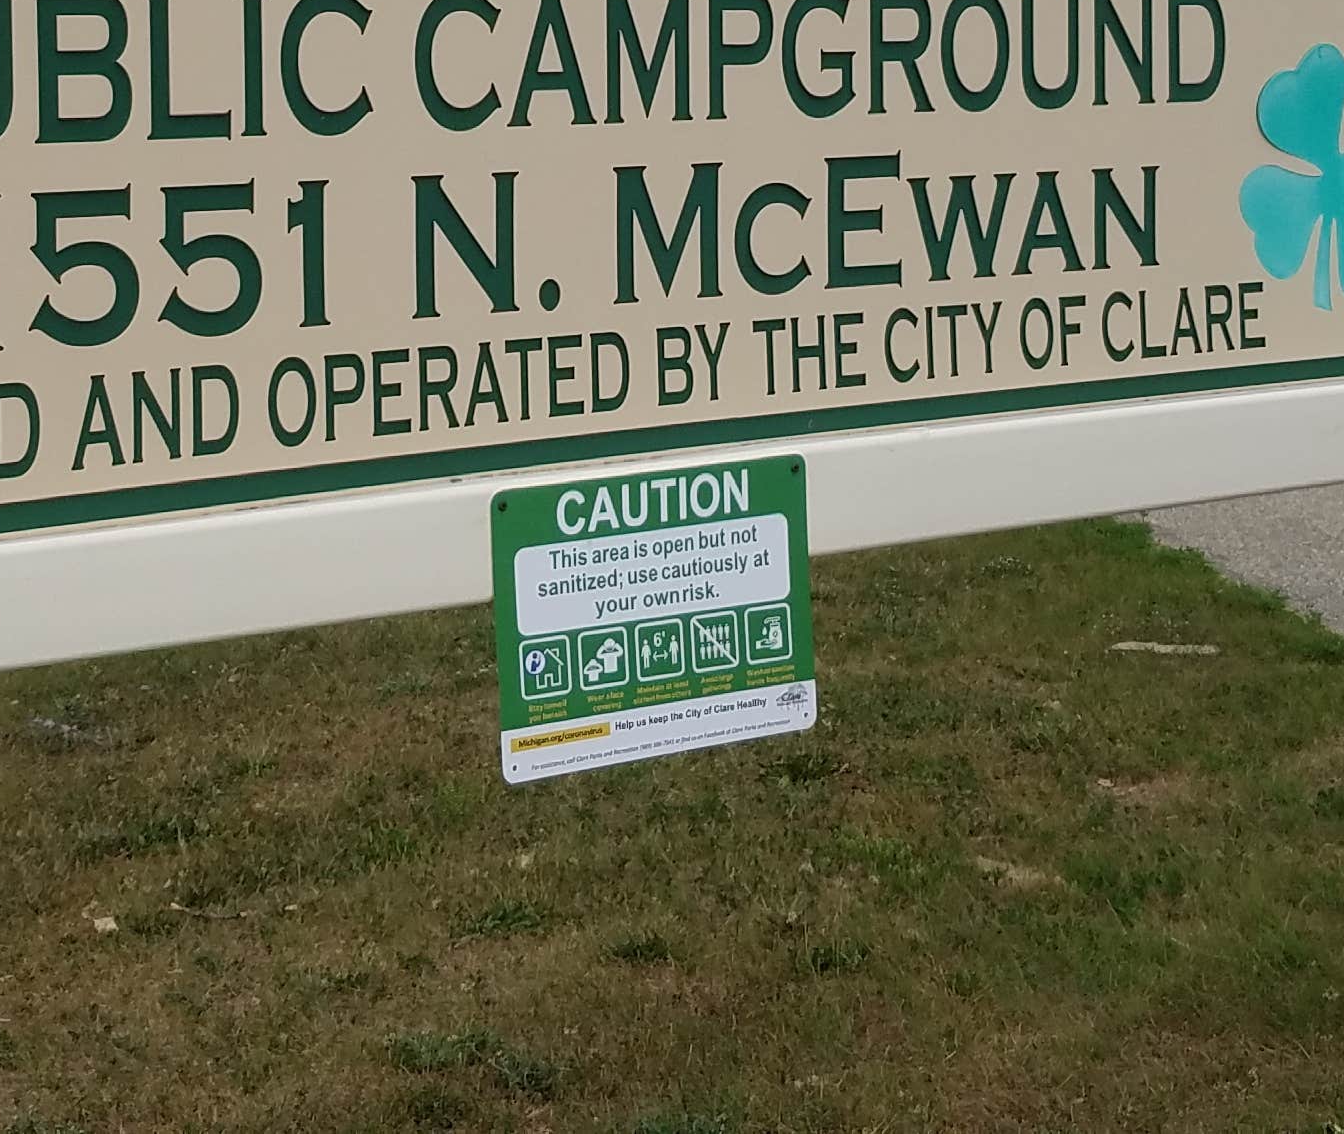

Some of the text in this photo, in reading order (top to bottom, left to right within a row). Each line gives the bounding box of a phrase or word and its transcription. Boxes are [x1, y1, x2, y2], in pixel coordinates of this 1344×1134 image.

[409, 170, 562, 321] N.
[70, 363, 241, 472] AND
[266, 330, 631, 449] OPERATED
[654, 320, 732, 408] BY
[751, 311, 868, 397] THE
[883, 300, 1004, 384] CITY
[1018, 293, 1088, 371] OF
[1100, 280, 1268, 364] CLARE
[556, 468, 750, 535] CAUTION
[548, 524, 757, 569] This area is open but not
[537, 549, 770, 597] sanitized; use cautiously at
[594, 581, 720, 620] your own risk.
[614, 720, 634, 731] Help
[636, 719, 647, 727] us
[648, 715, 669, 725] keep
[670, 712, 683, 722] the
[685, 707, 702, 719] City
[703, 705, 712, 714] of
[714, 703, 735, 714] Clare
[736, 698, 767, 711] Healthy
